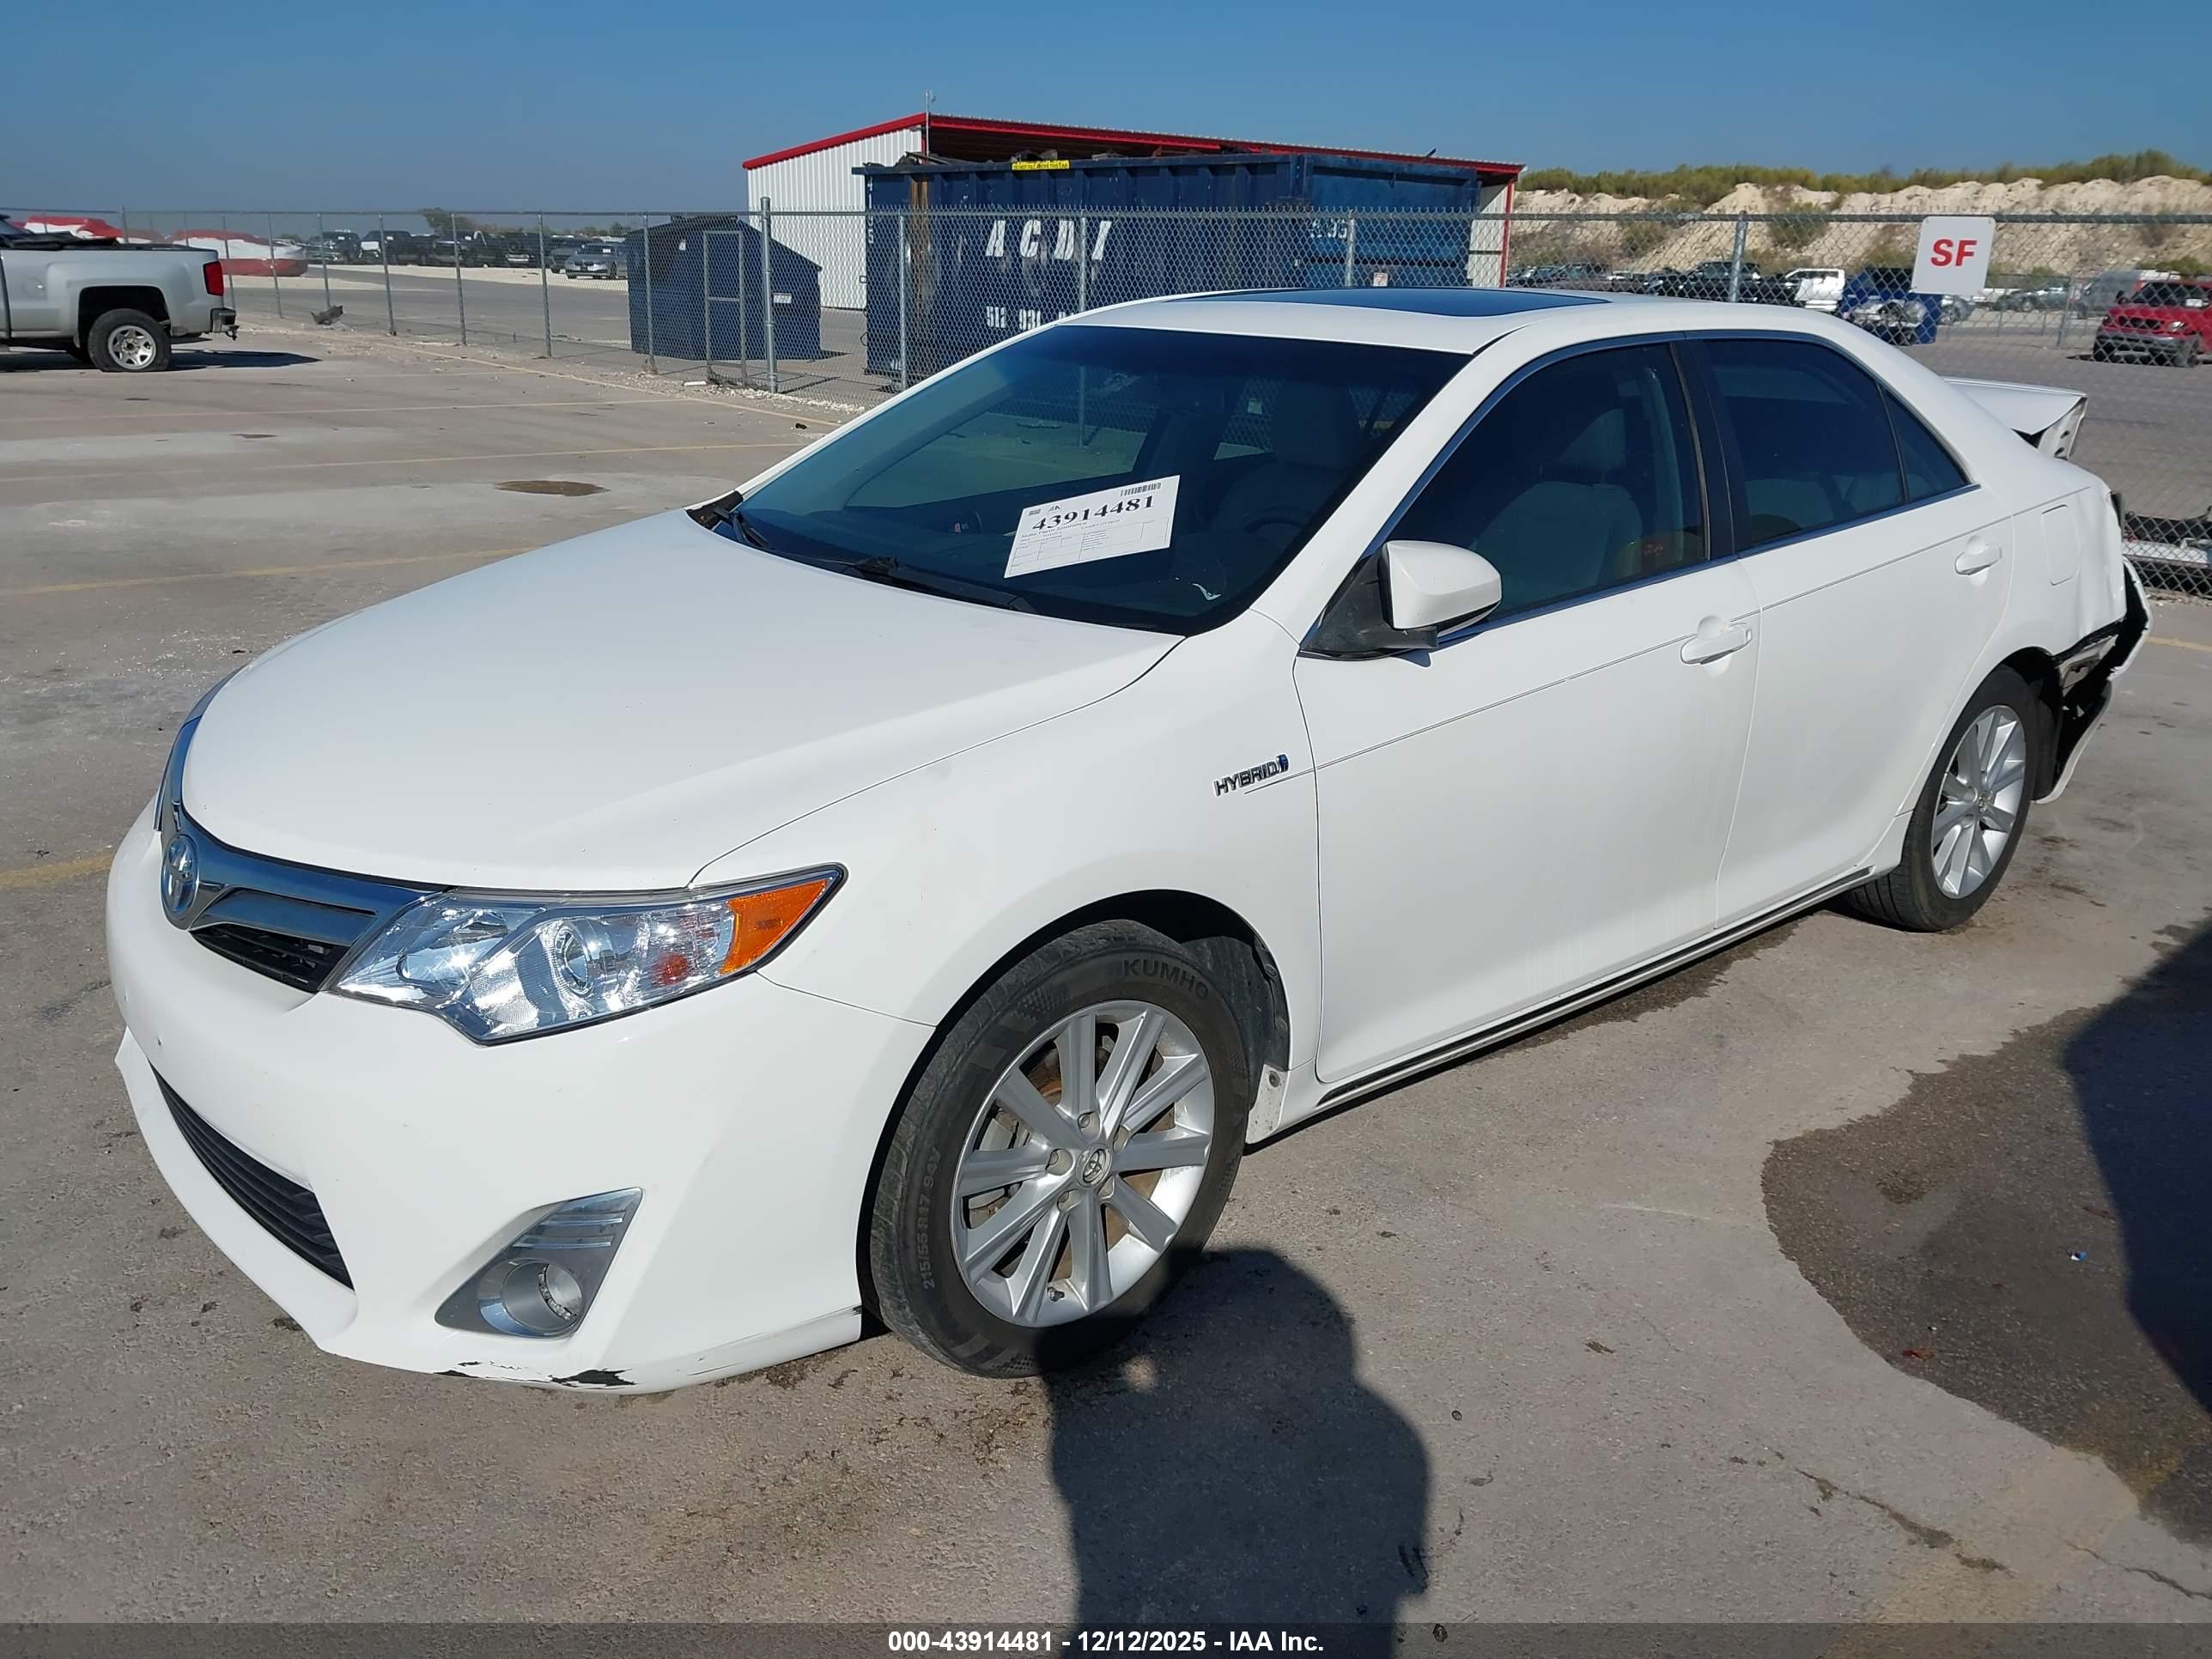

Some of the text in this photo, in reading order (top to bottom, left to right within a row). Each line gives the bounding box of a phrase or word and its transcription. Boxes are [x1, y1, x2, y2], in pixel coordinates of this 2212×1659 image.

[1930, 239, 1978, 266] SF
[1033, 495, 1153, 531] 43914481
[1213, 761, 1278, 797] HYBRID
[1123, 958, 1209, 999] KUMHO
